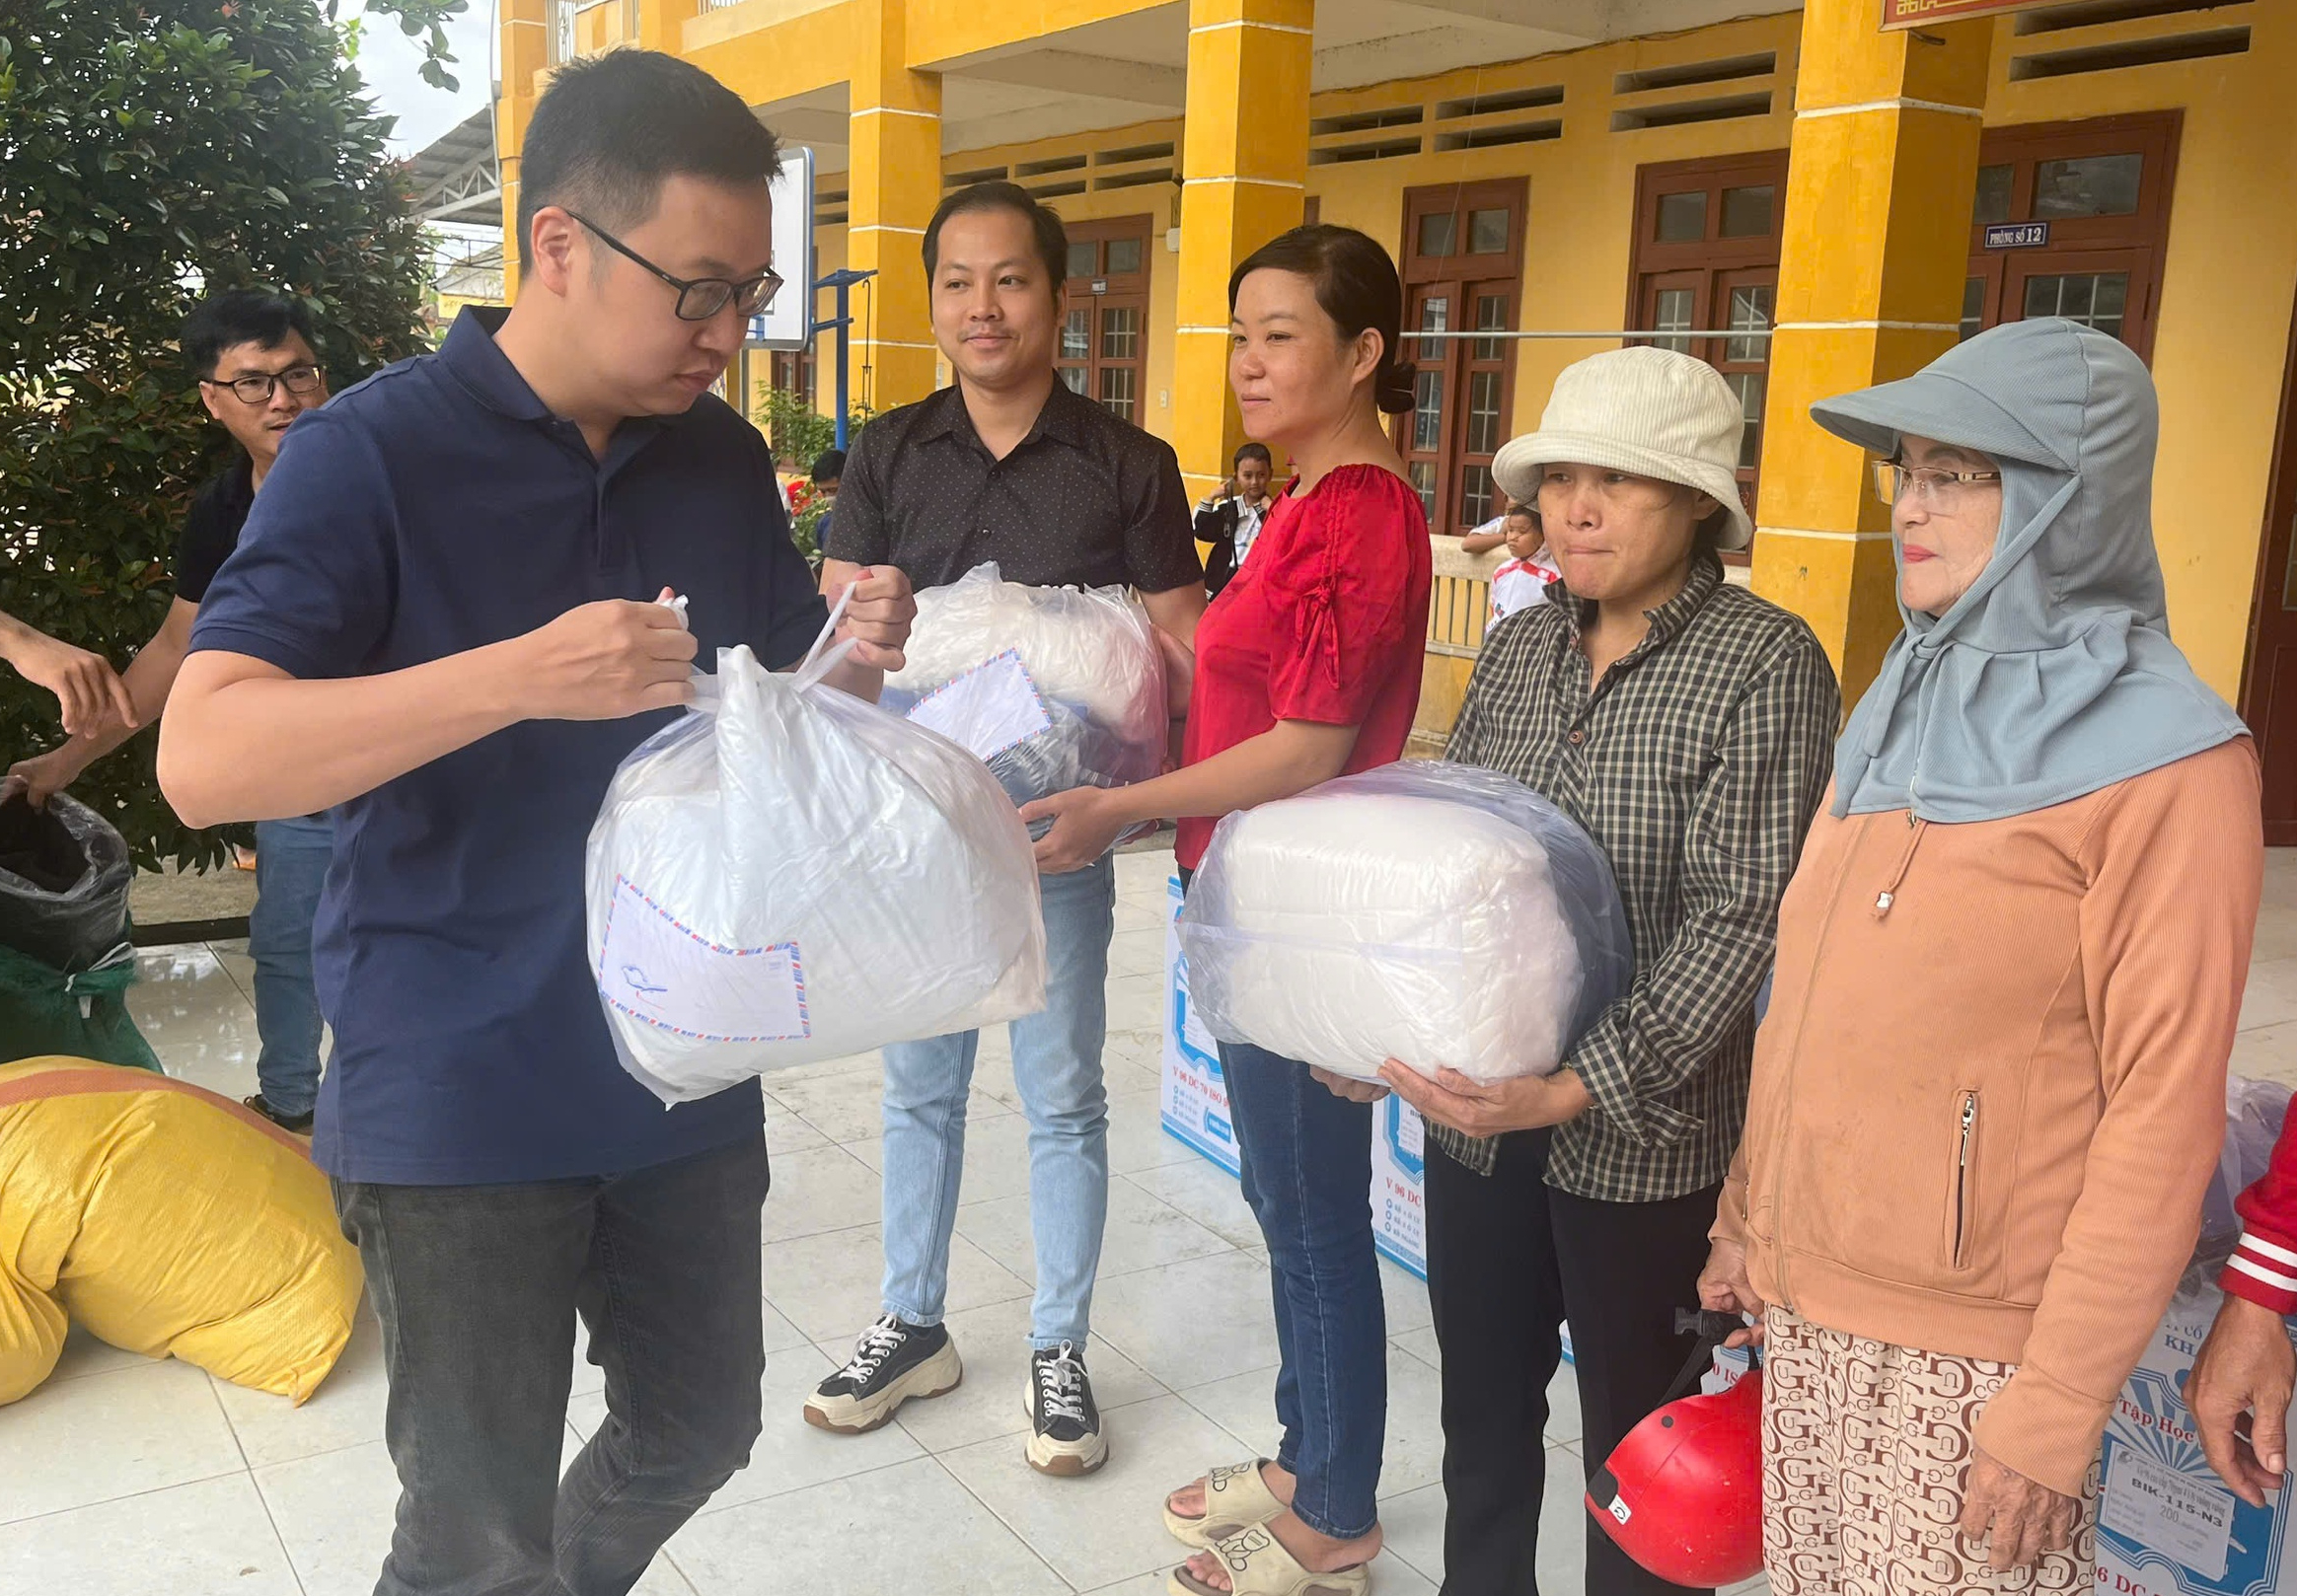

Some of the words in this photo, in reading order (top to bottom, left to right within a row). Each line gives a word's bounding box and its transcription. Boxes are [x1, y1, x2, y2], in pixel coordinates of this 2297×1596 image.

[1989, 230, 2014, 245] PHÒNG
[2015, 226, 2026, 243] SỐ
[2027, 227, 2041, 243] 12
[1188, 1075, 1199, 1090] DC
[1386, 1177, 1393, 1190] V
[1407, 1190, 1422, 1207] DC
[2164, 1334, 2196, 1357] KH
[2118, 1398, 2153, 1427] Tập
[2159, 1415, 2194, 1443] Học
[2131, 1478, 2223, 1528] BIK-115-N3
[2159, 1504, 2180, 1524] 200
[2097, 1566, 2109, 1583] 6
